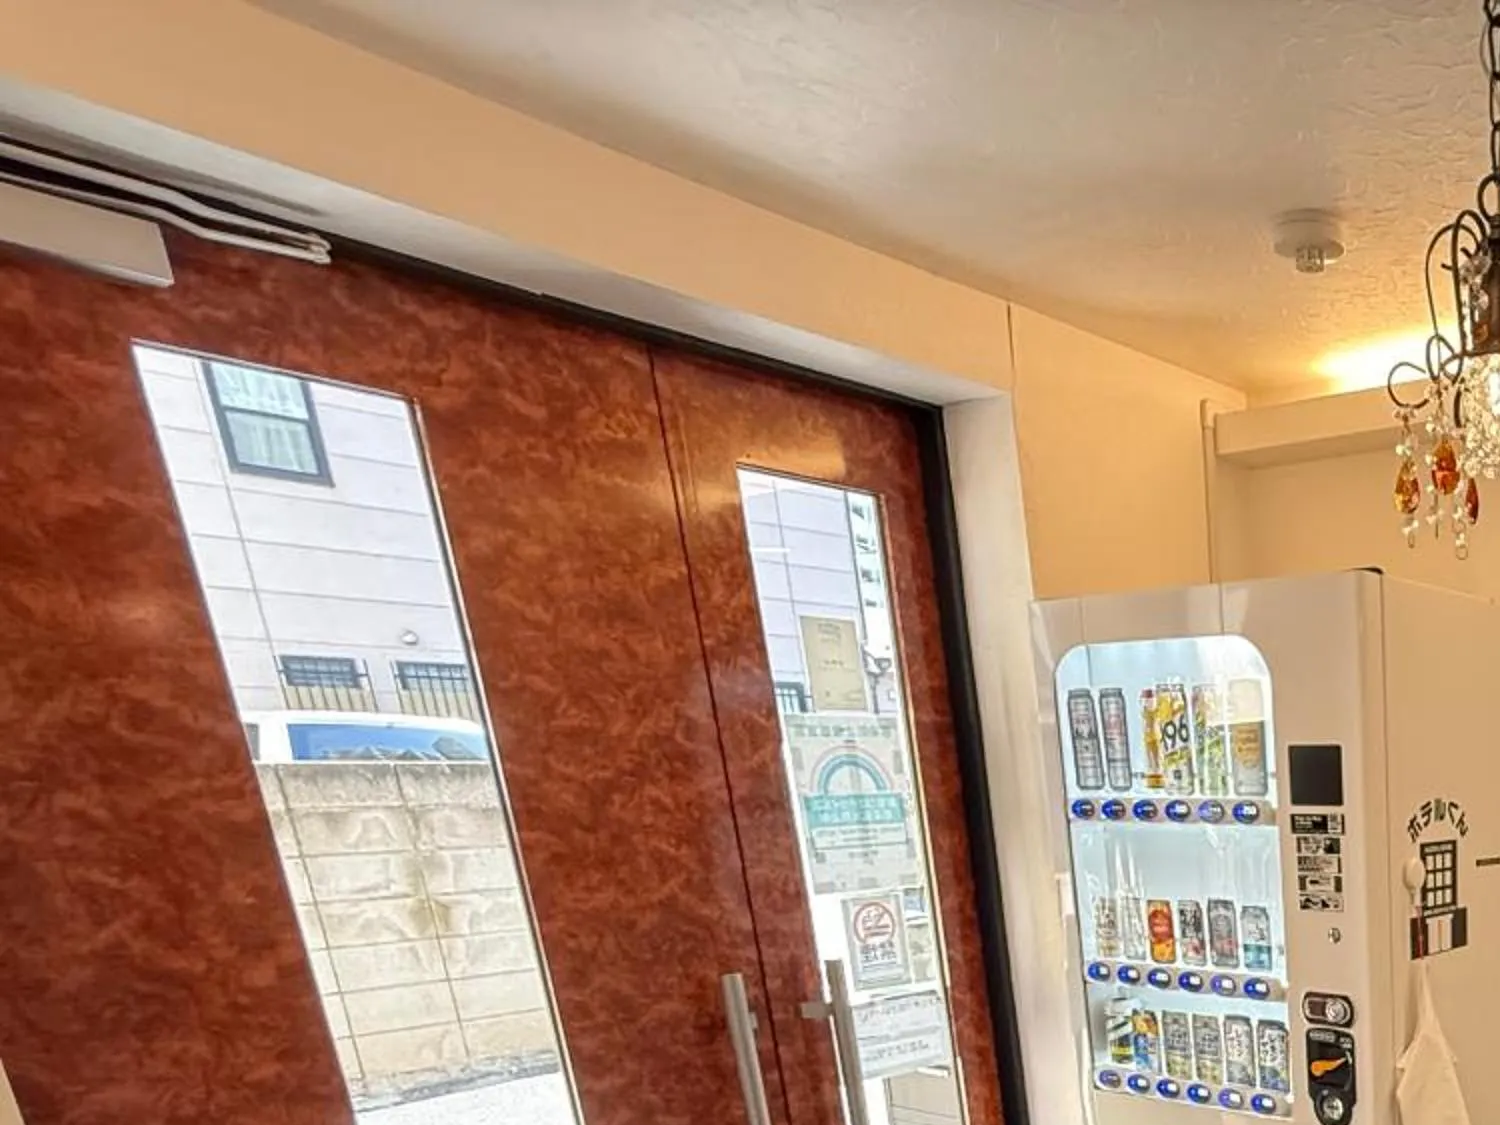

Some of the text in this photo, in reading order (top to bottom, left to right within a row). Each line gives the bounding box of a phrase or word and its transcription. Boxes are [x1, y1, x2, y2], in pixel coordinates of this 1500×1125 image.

[1407, 798, 1469, 842] ホテルくん
